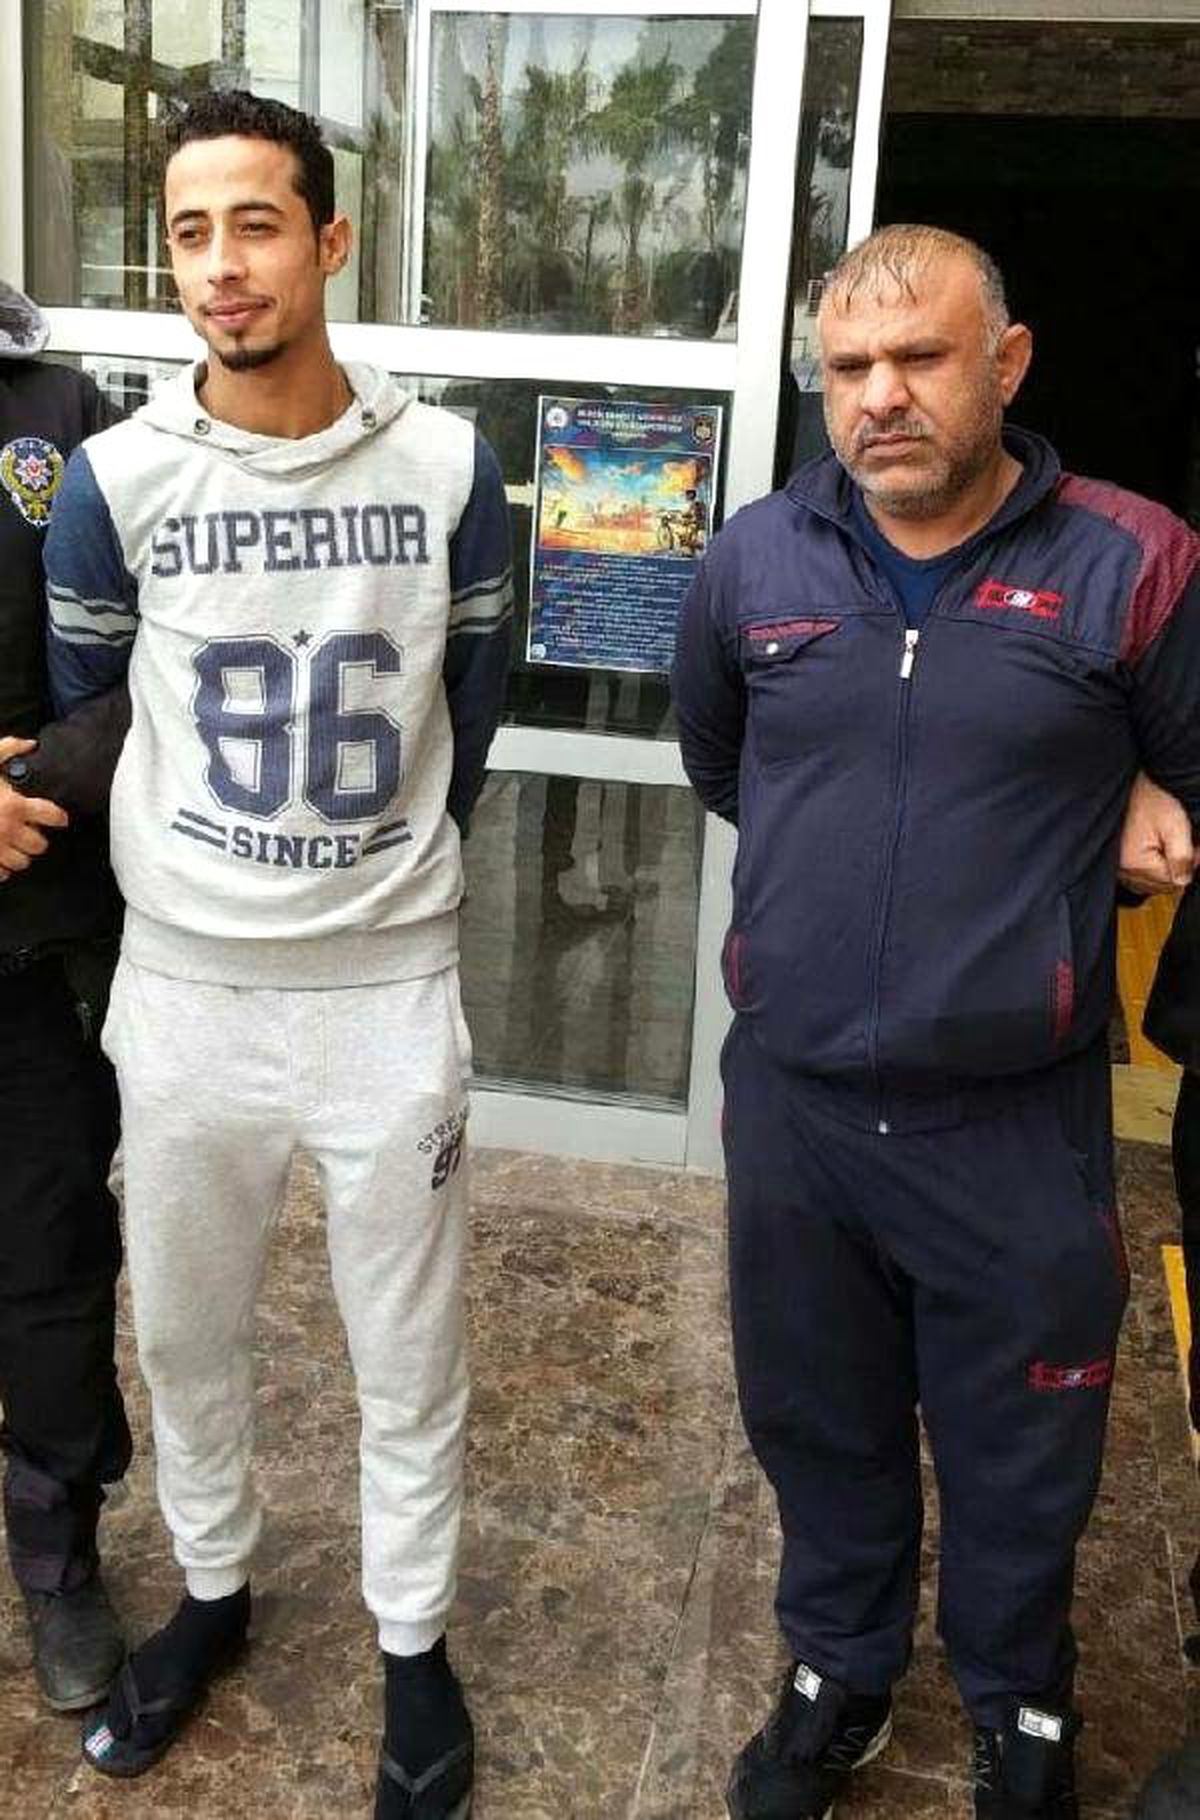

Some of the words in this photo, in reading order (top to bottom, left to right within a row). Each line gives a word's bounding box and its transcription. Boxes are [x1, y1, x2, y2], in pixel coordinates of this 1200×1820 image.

[151, 504, 430, 577] SUPERIOR
[190, 628, 405, 825] 86
[226, 825, 361, 869] SINCE
